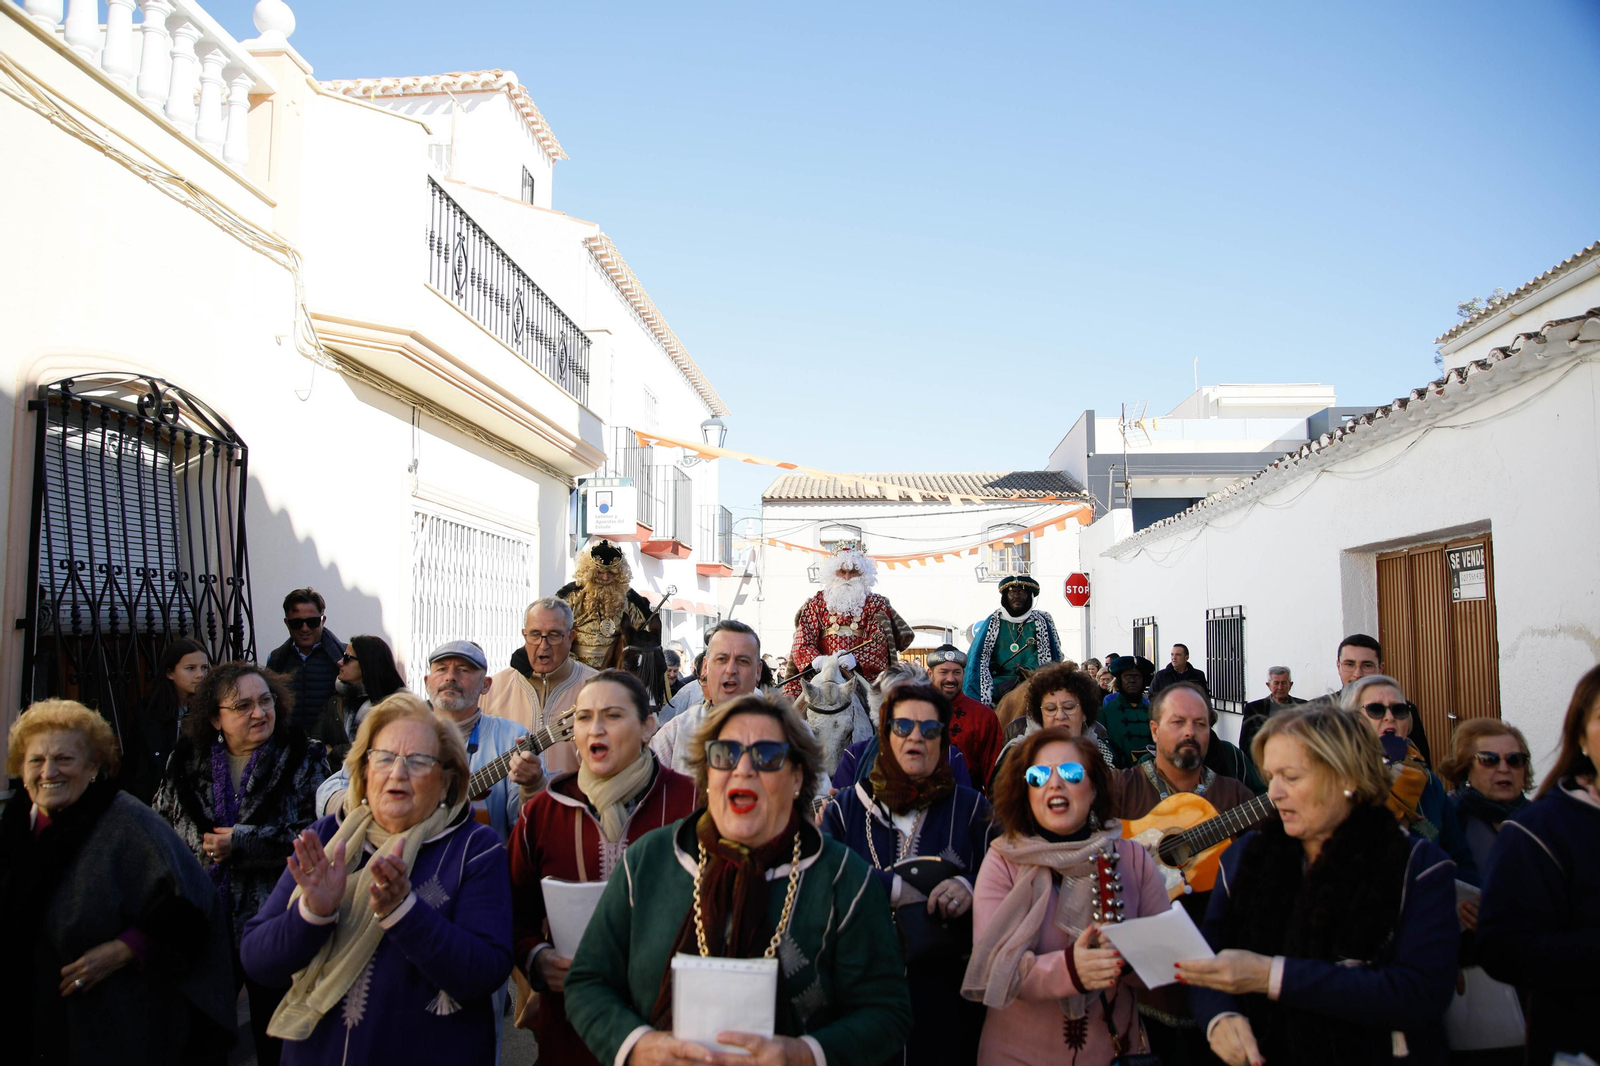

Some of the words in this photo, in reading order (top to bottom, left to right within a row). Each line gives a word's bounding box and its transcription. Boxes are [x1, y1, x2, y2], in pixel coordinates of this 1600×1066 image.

[1450, 552, 1460, 570] SE
[1462, 549, 1484, 568] VENDE
[1066, 586, 1090, 594] STOP
